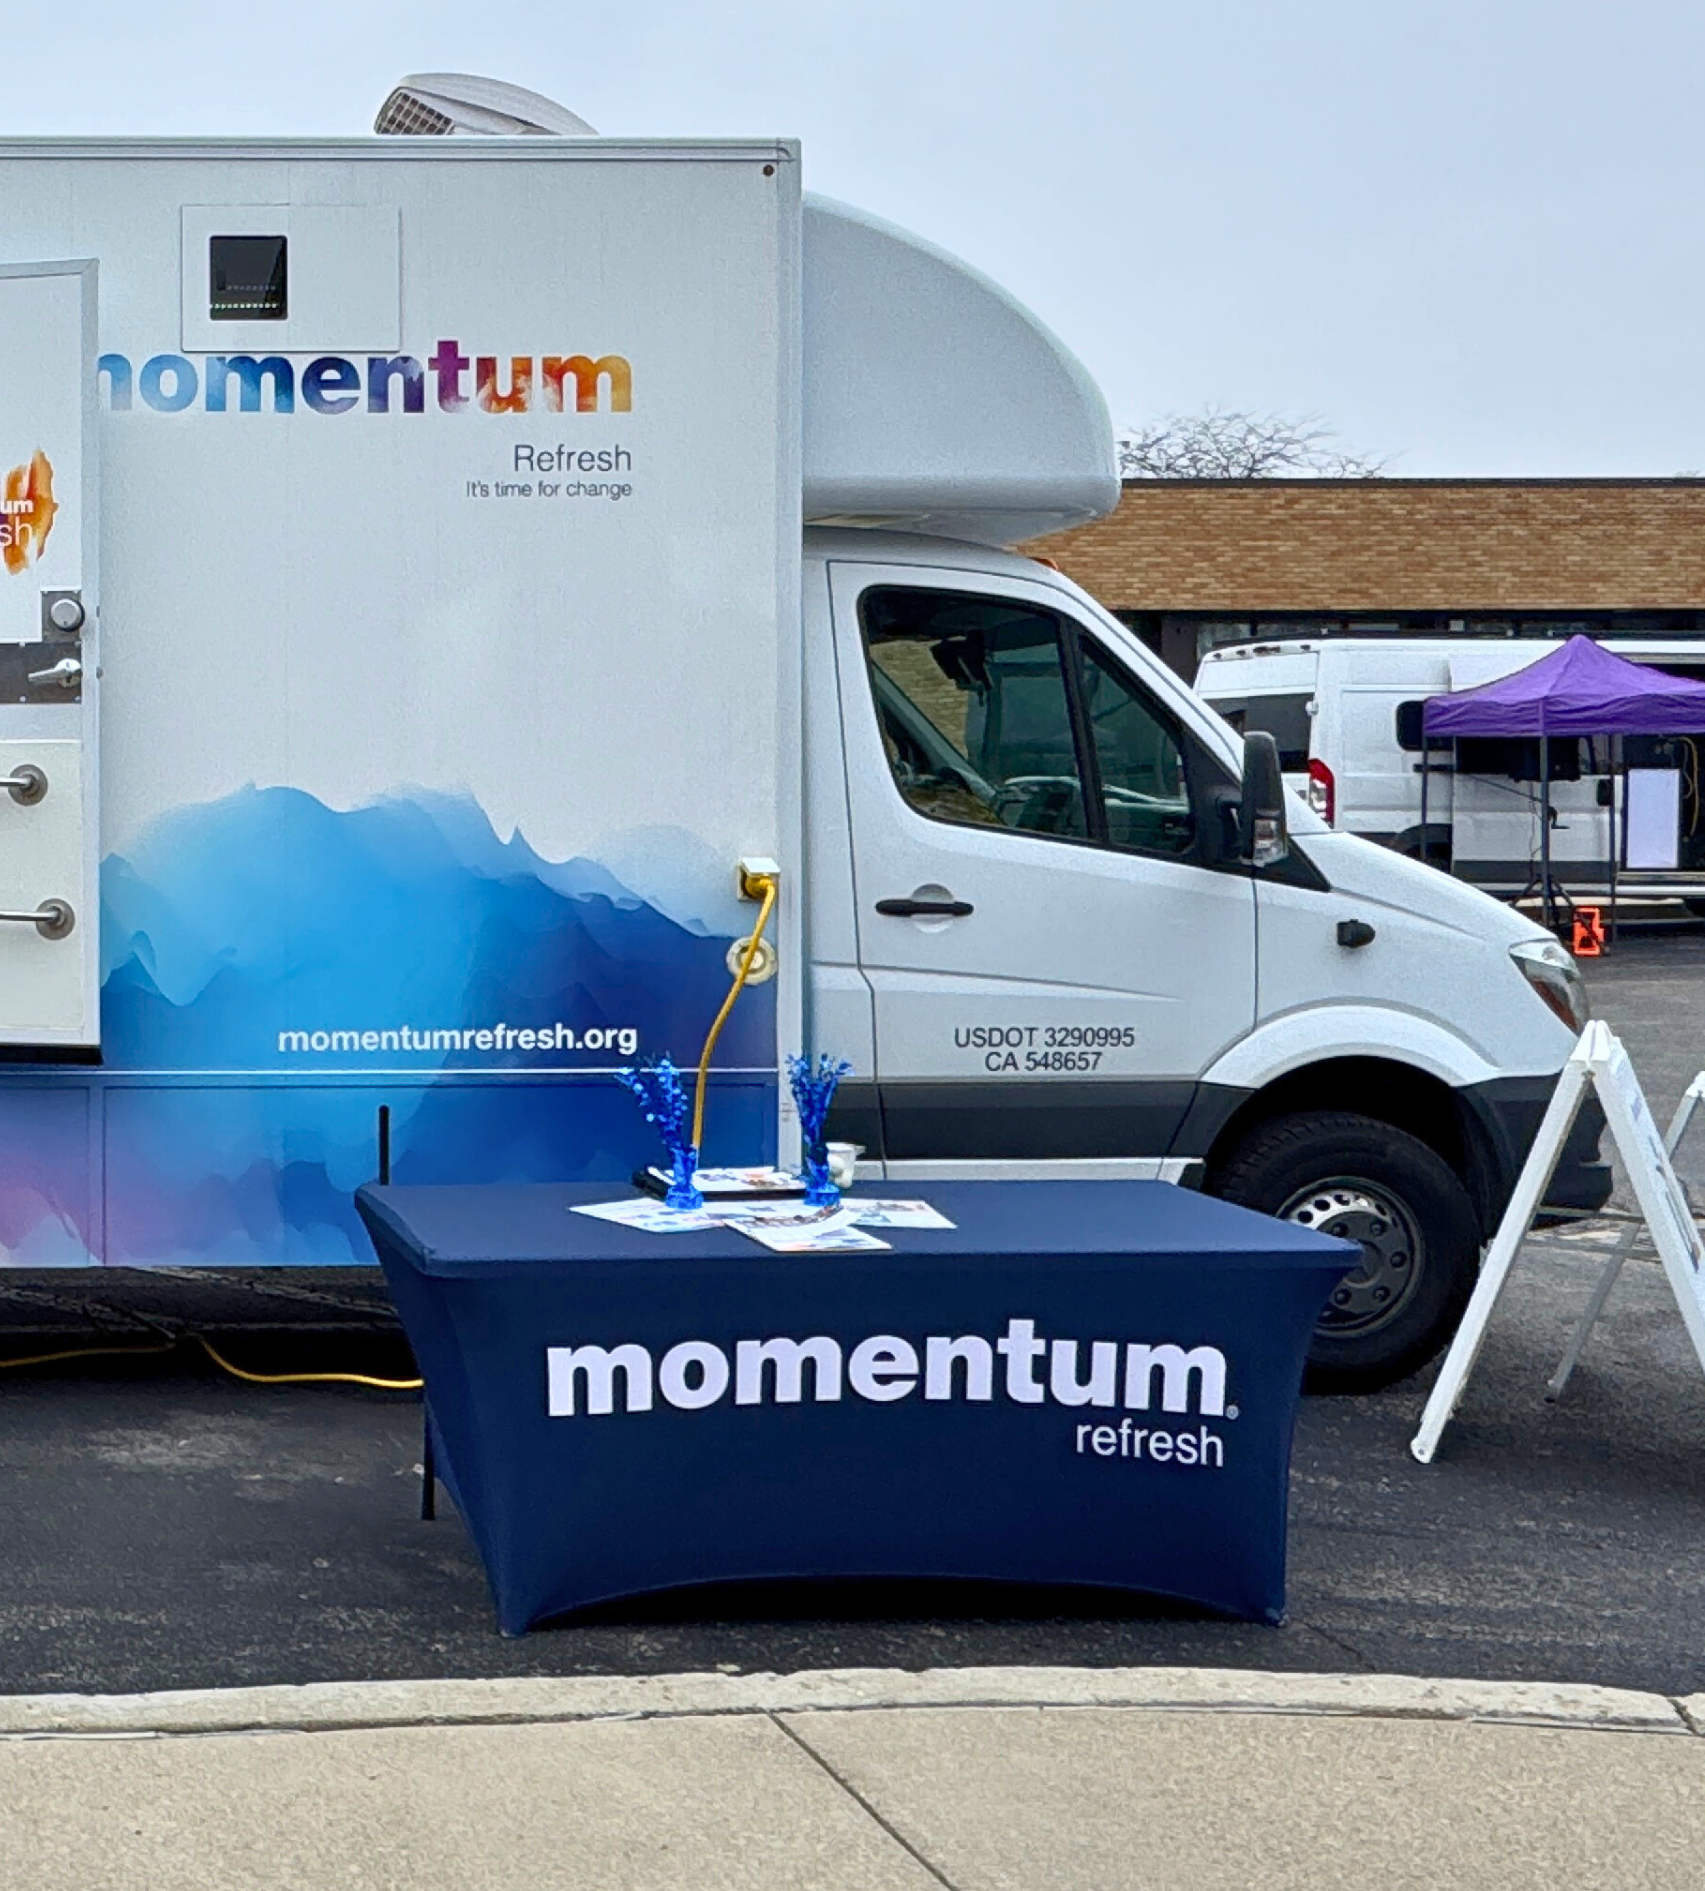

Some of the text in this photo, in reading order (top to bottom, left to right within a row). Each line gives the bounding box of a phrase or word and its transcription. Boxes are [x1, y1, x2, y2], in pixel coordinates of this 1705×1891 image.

[514, 444, 632, 471] Refresh
[466, 480, 633, 501] It's time for change
[278, 1023, 637, 1055] momentumrefresh.org
[954, 1027, 1135, 1048] USDOT 3290995
[984, 1051, 1103, 1071] CA 548657
[1076, 1417, 1224, 1467] refresh
